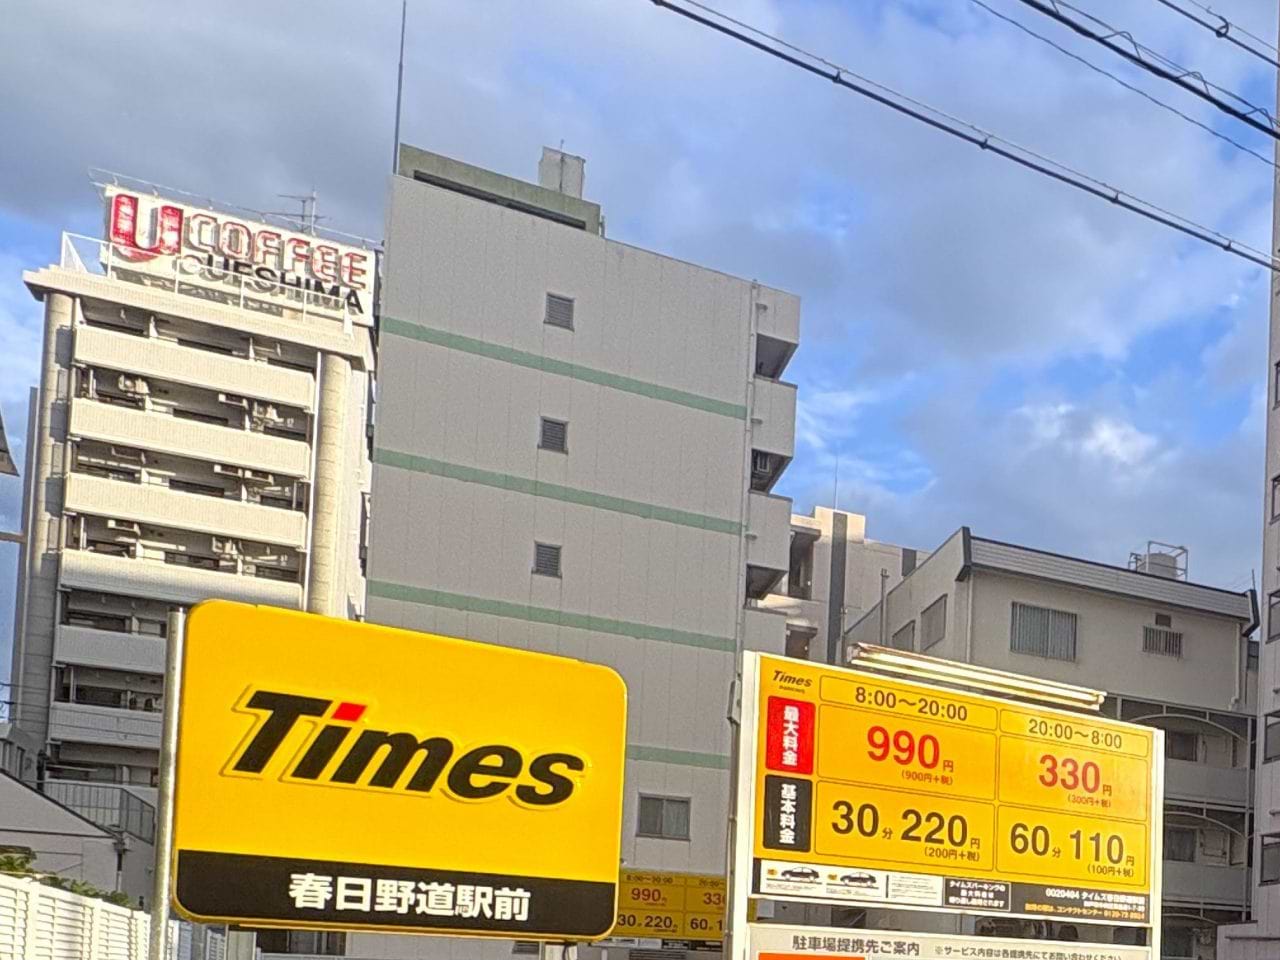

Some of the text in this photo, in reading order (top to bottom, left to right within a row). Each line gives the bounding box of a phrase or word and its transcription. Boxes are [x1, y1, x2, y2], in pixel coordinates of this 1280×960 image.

[190, 213, 367, 290] COFFEE
[772, 669, 813, 688] Times
[230, 688, 587, 807] Times
[781, 705, 800, 767] 最大料金
[779, 783, 798, 845] 基本料金
[289, 871, 532, 922] 春日野道駅前
[792, 935, 920, 957] 駐車場提携先ご案内
